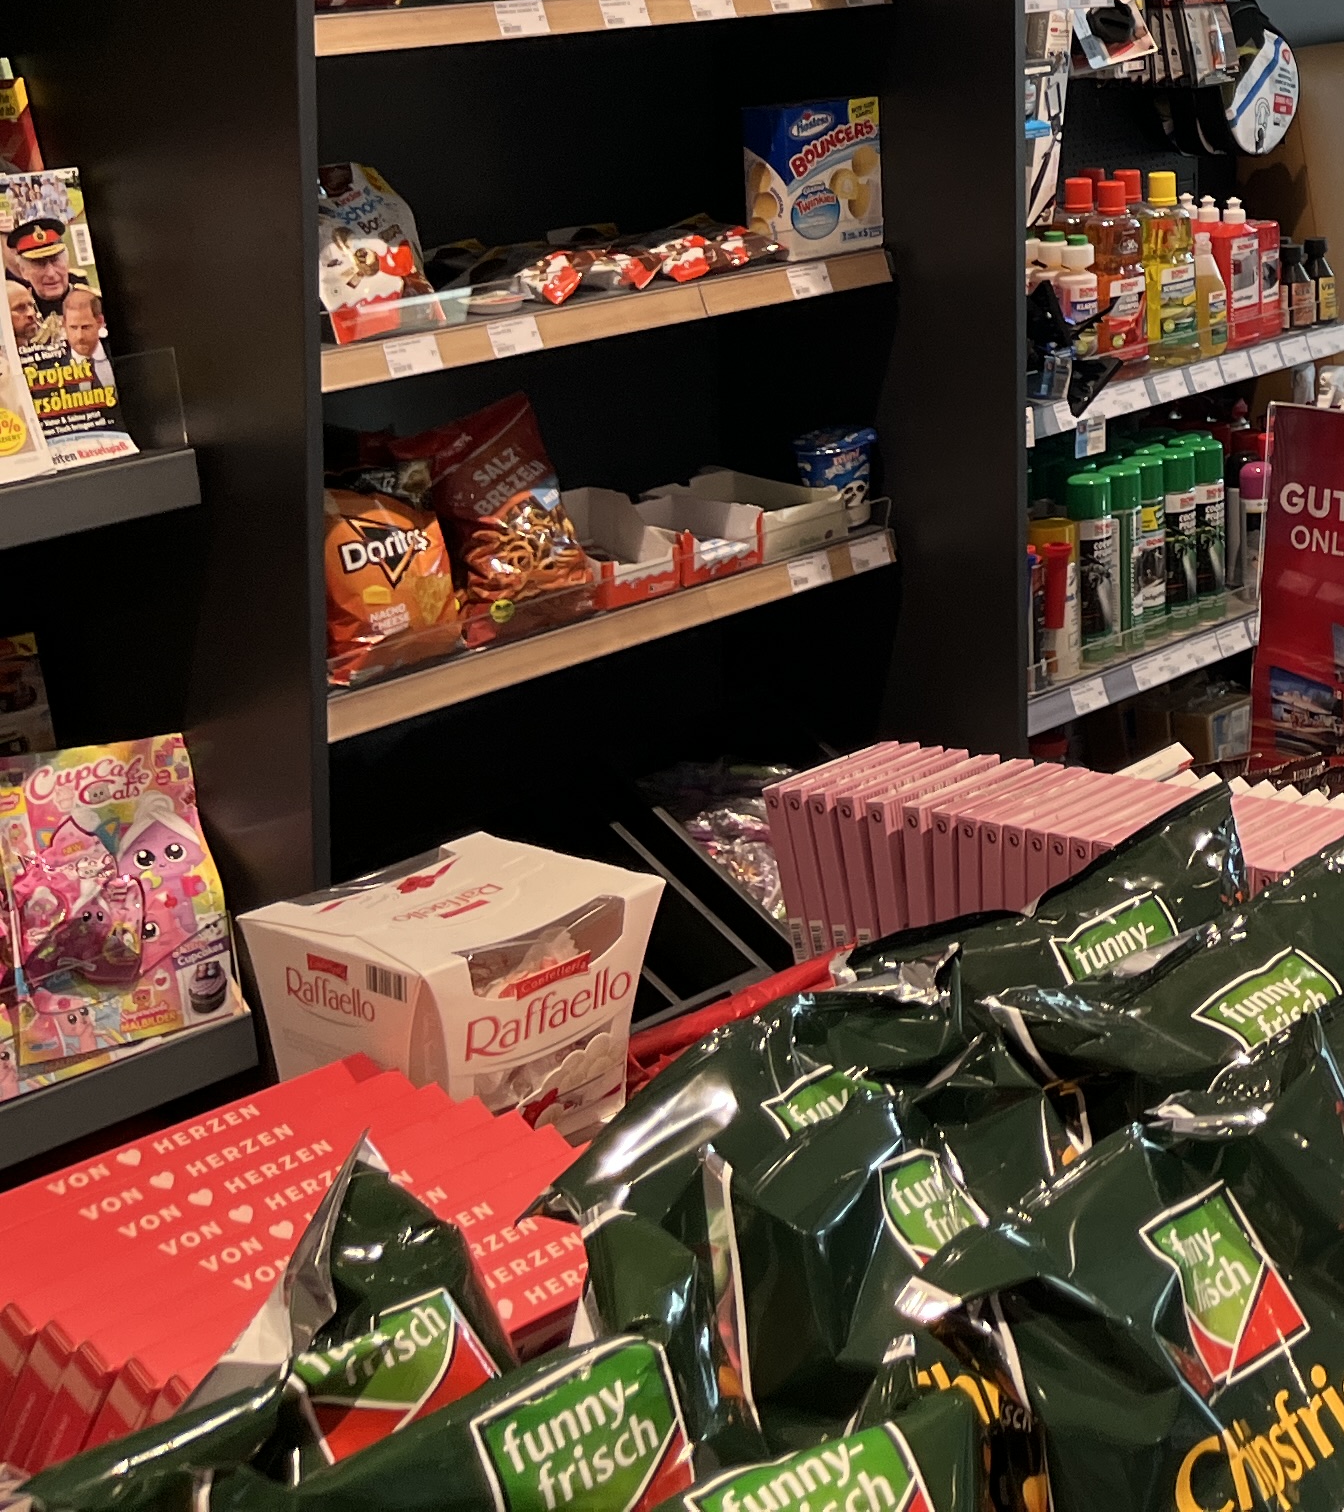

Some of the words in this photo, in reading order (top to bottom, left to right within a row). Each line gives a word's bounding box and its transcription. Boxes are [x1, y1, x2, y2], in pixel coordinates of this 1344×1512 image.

[790, 120, 876, 179] BOUNCERS
[24, 358, 93, 388] Projekt
[33, 385, 118, 415] rsöhnung
[472, 446, 521, 488] SALZ
[473, 459, 548, 516] BREZELN
[340, 529, 429, 572] Doritos
[369, 603, 407, 622] NACHO
[371, 612, 410, 632] CHEESE
[26, 757, 151, 803] CupCake
[1073, 923, 1156, 974] funny-
[285, 966, 376, 1024] Raffaello
[465, 964, 633, 1063] Raffaello
[1219, 965, 1302, 1026] funny-
[1256, 986, 1329, 1041] frisch
[46, 1161, 111, 1197] VON
[151, 1103, 263, 1156] HERZEN
[78, 1187, 144, 1223] VON
[184, 1123, 297, 1179] HERZEN
[117, 1203, 183, 1240] VON
[223, 1138, 335, 1195] HERZEN
[157, 1220, 224, 1258] VON
[264, 1168, 340, 1213] HERZ
[199, 1237, 264, 1274] VON
[232, 1255, 292, 1294] VON
[524, 1263, 589, 1307] HERZ
[502, 1375, 641, 1474] funny-
[536, 1410, 660, 1511] frisch
[720, 1439, 866, 1512] funny-
